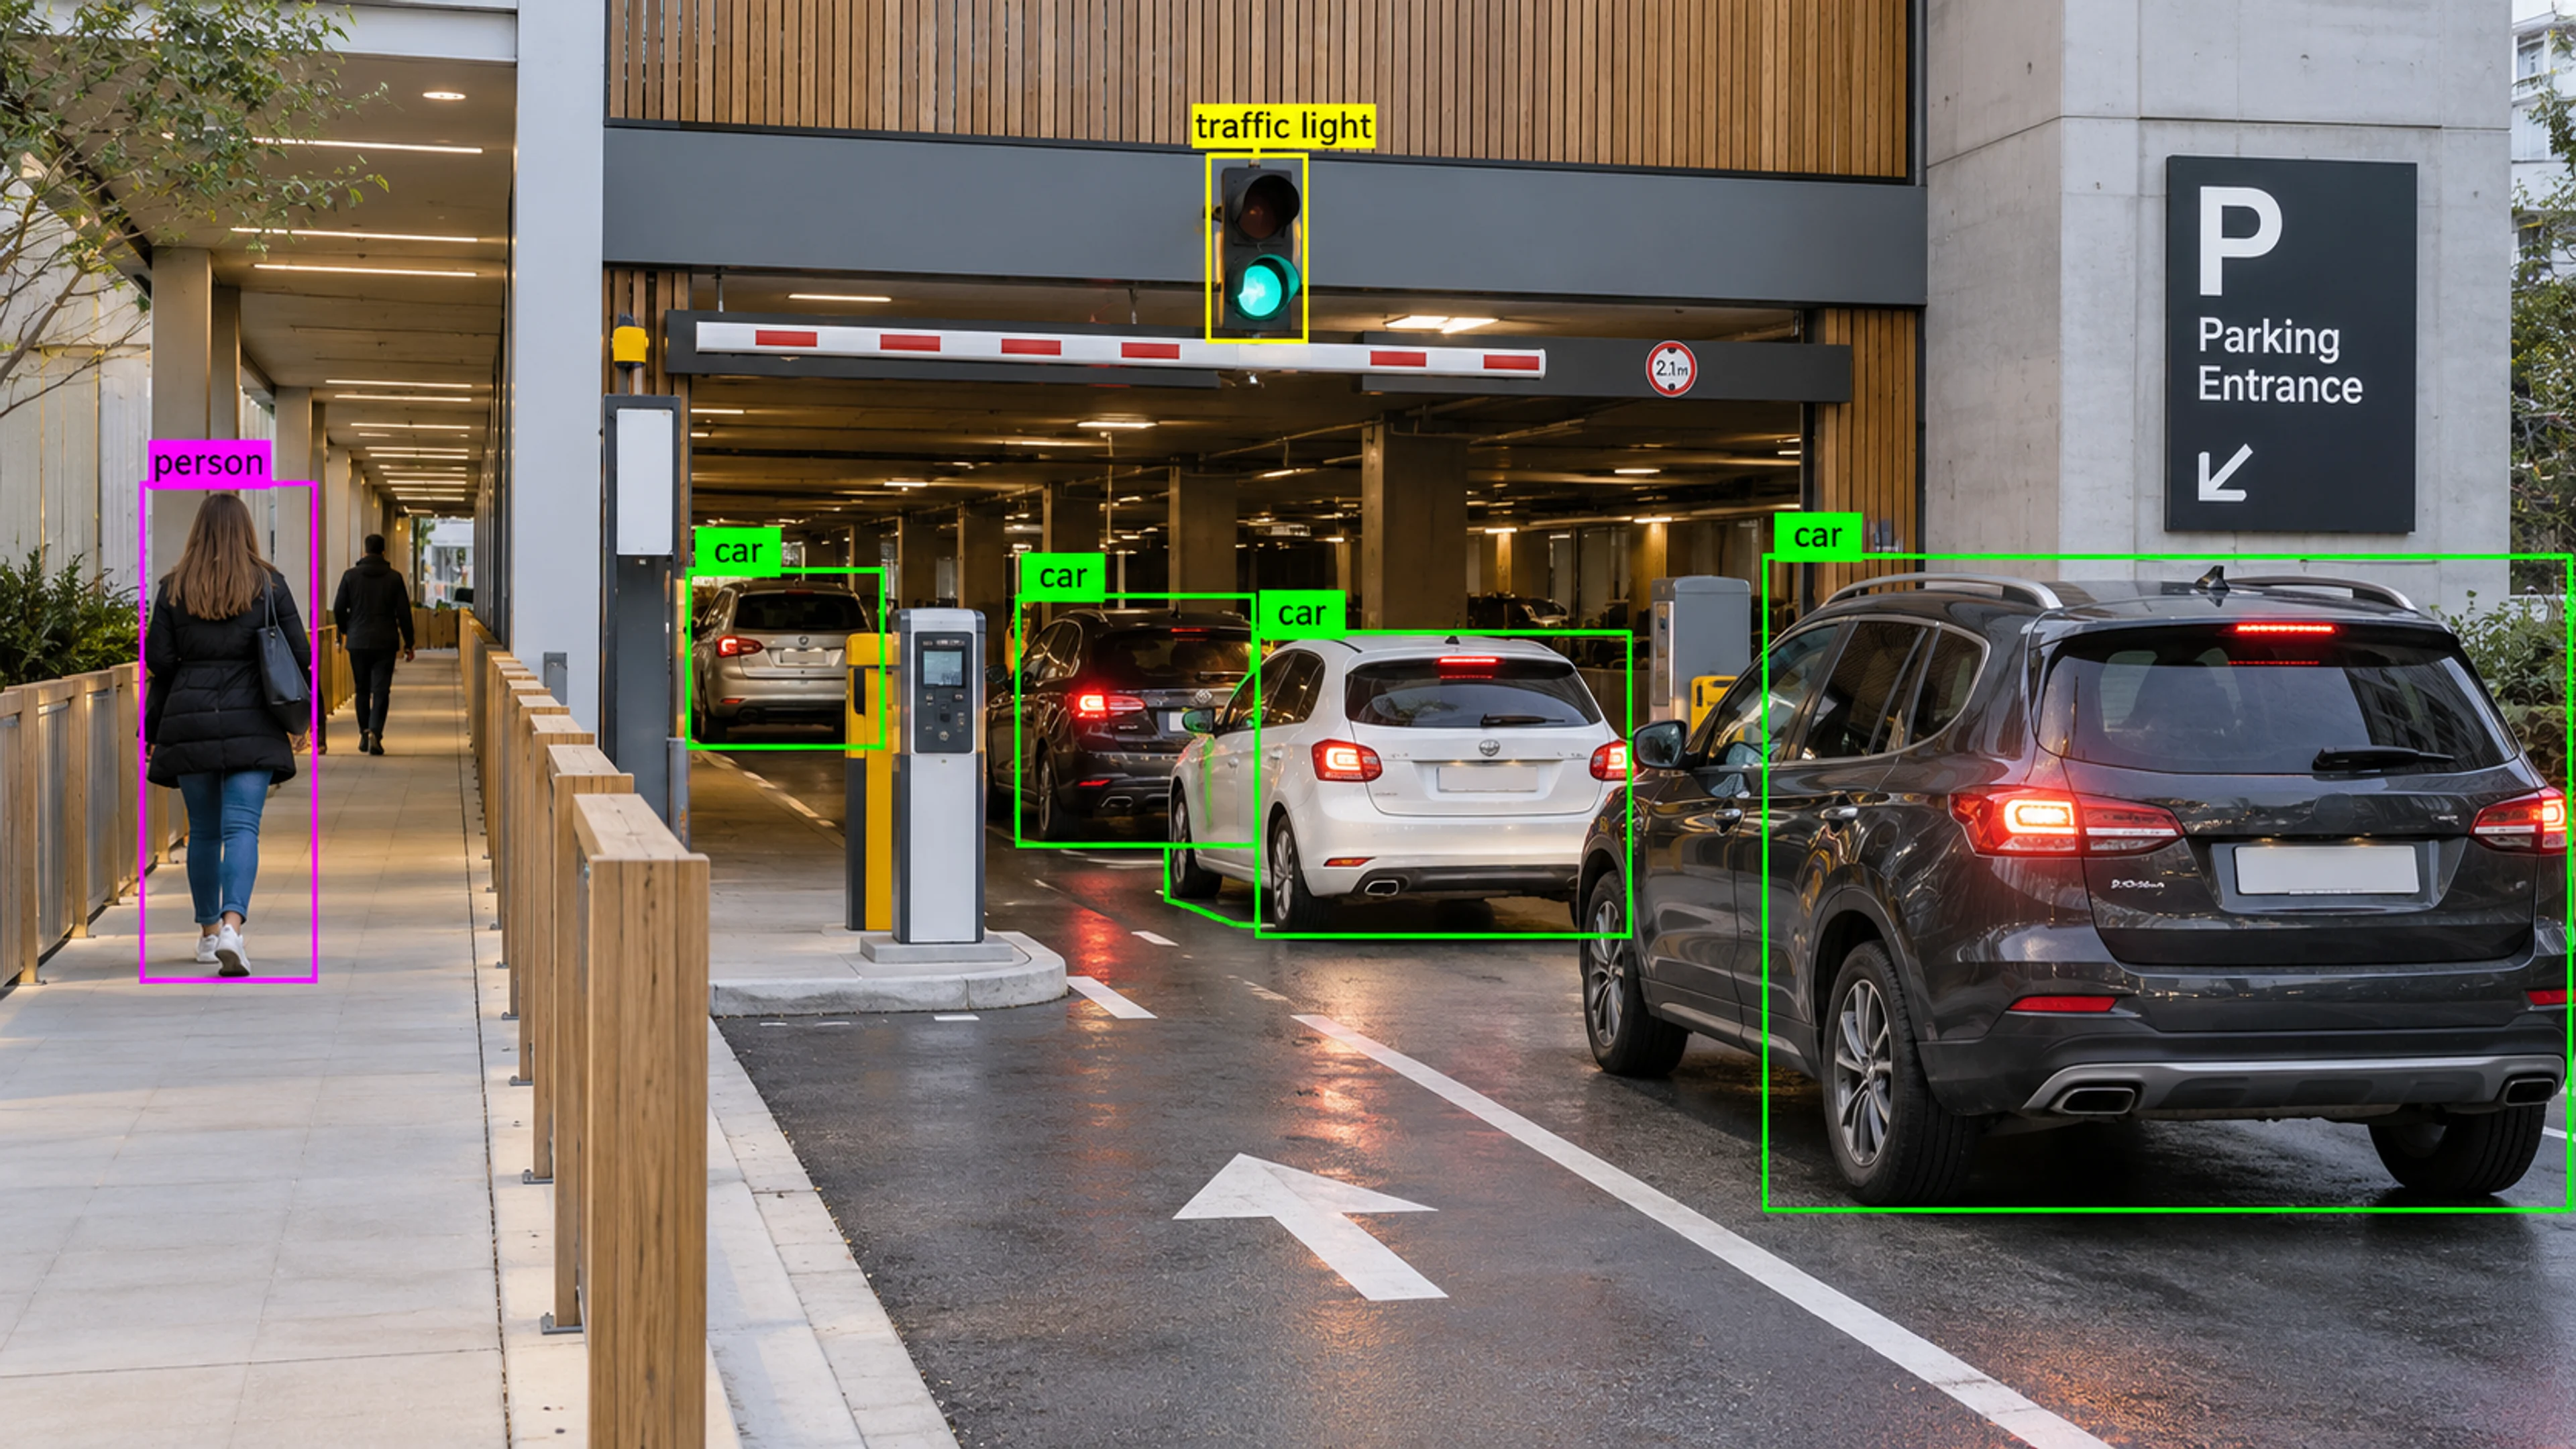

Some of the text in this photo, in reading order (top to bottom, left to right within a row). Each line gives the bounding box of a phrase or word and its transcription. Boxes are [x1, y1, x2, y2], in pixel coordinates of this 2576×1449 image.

[2200, 185, 2283, 297] P
[2199, 317, 2340, 364] Parking
[2199, 365, 2363, 404] Entrance
